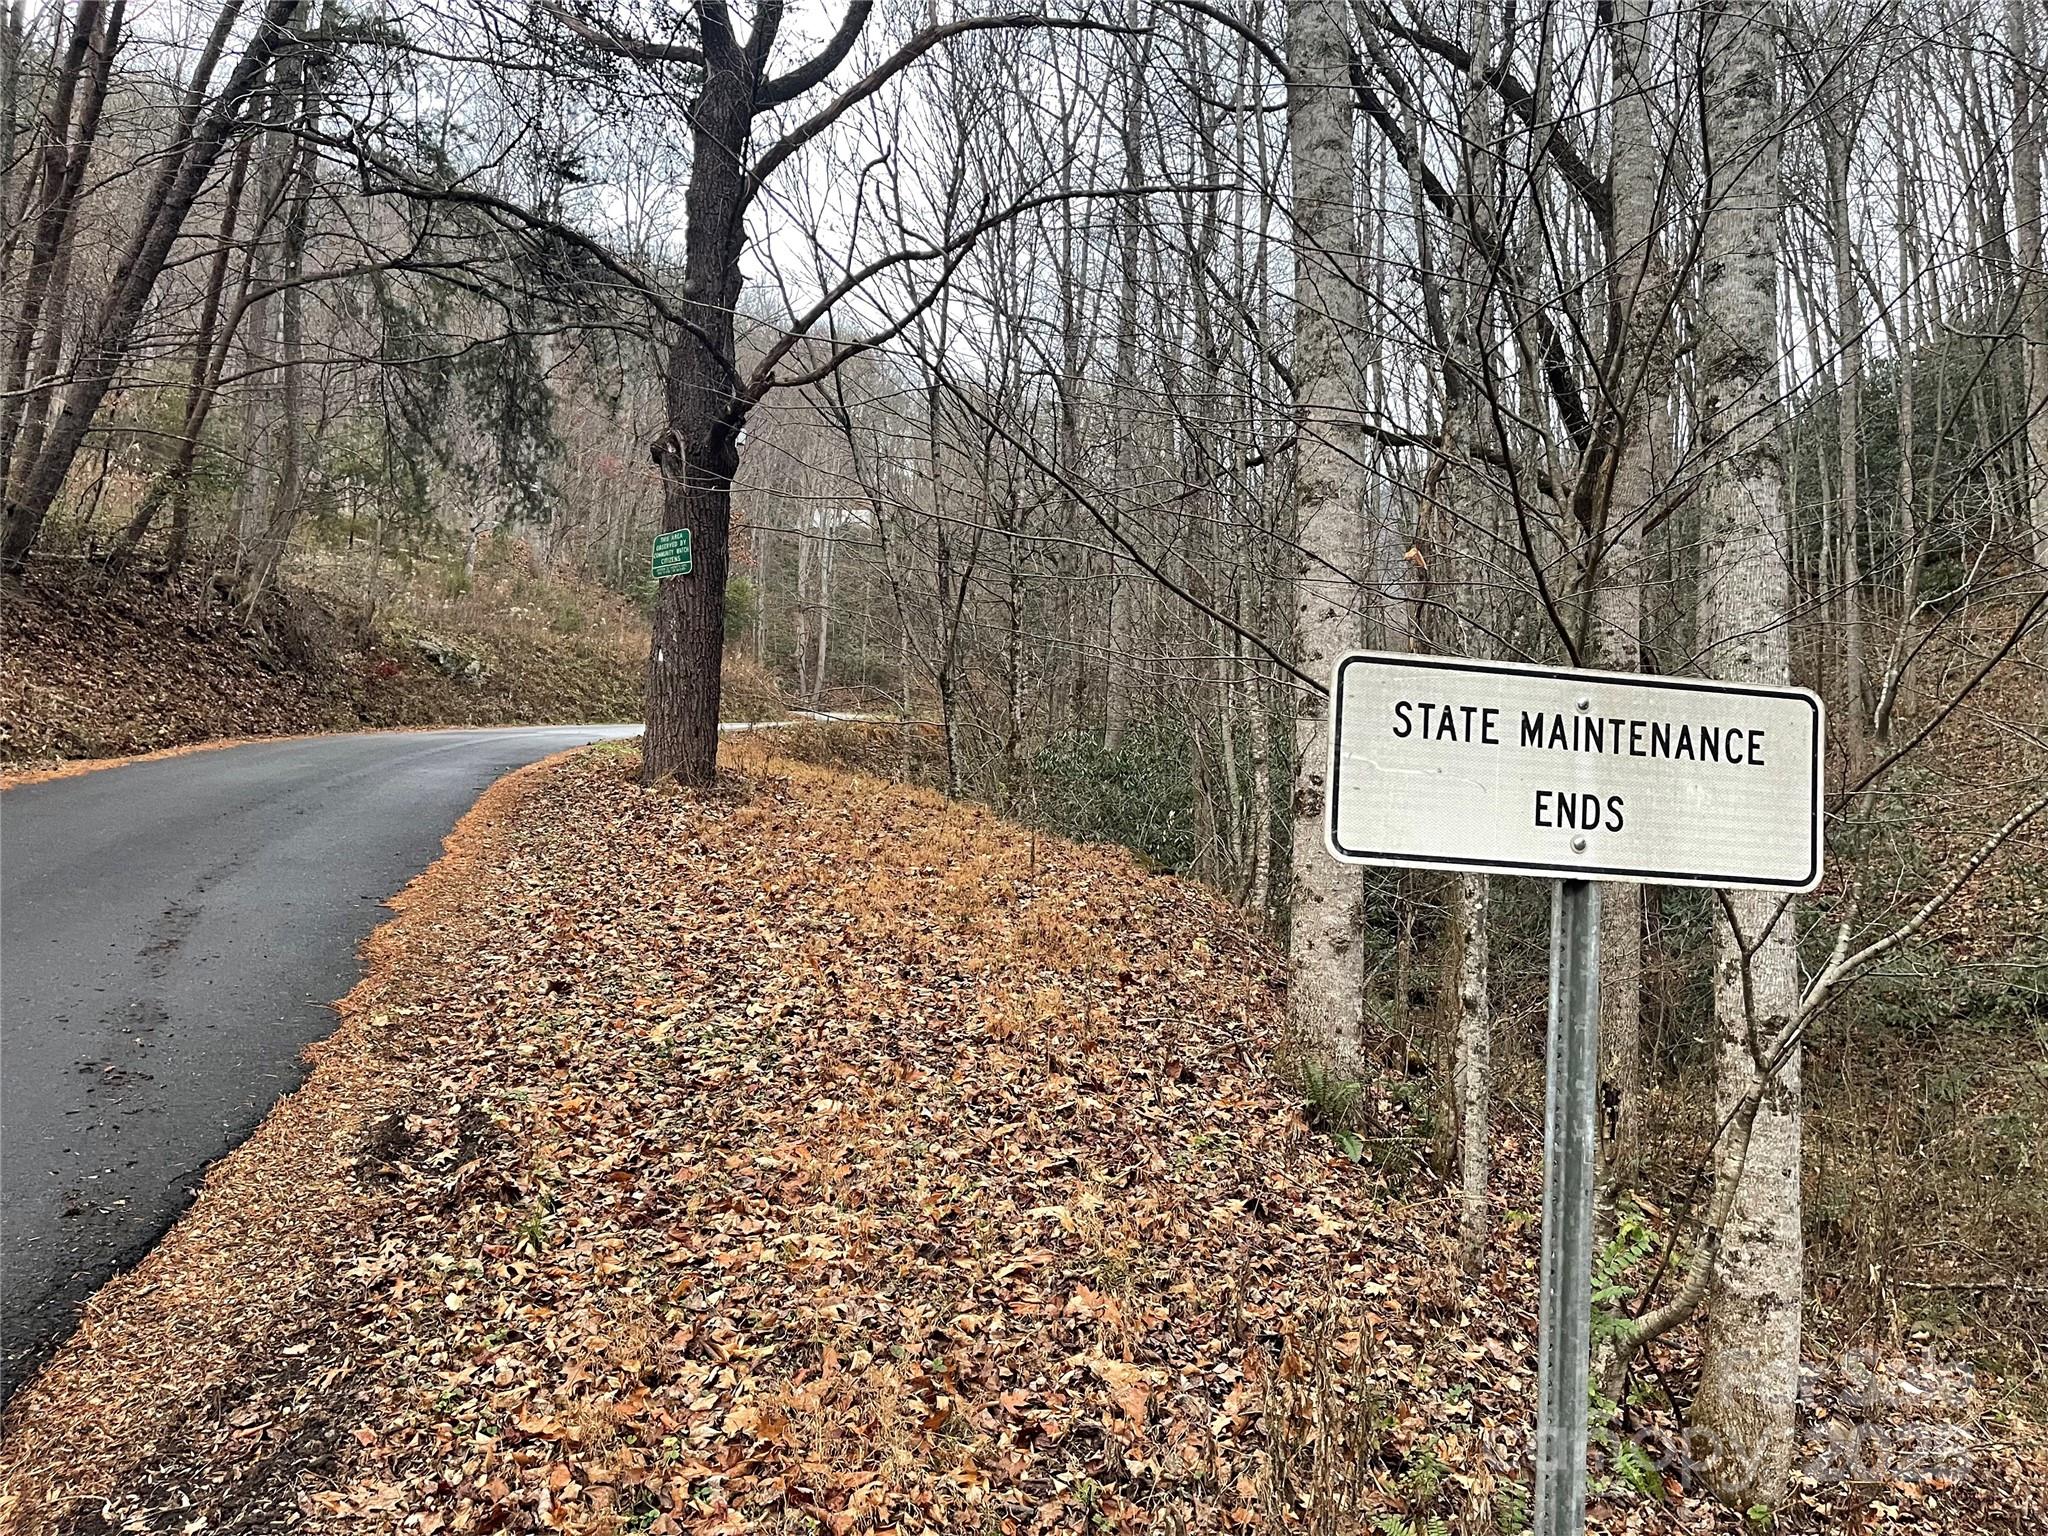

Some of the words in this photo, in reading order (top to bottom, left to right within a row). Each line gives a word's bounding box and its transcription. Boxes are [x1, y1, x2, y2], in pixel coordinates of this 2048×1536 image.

[680, 539, 687, 547] BY
[1391, 700, 1500, 745] STATE
[1520, 710, 1766, 766] MAINTENANCE
[1534, 790, 1624, 832] ENDS
